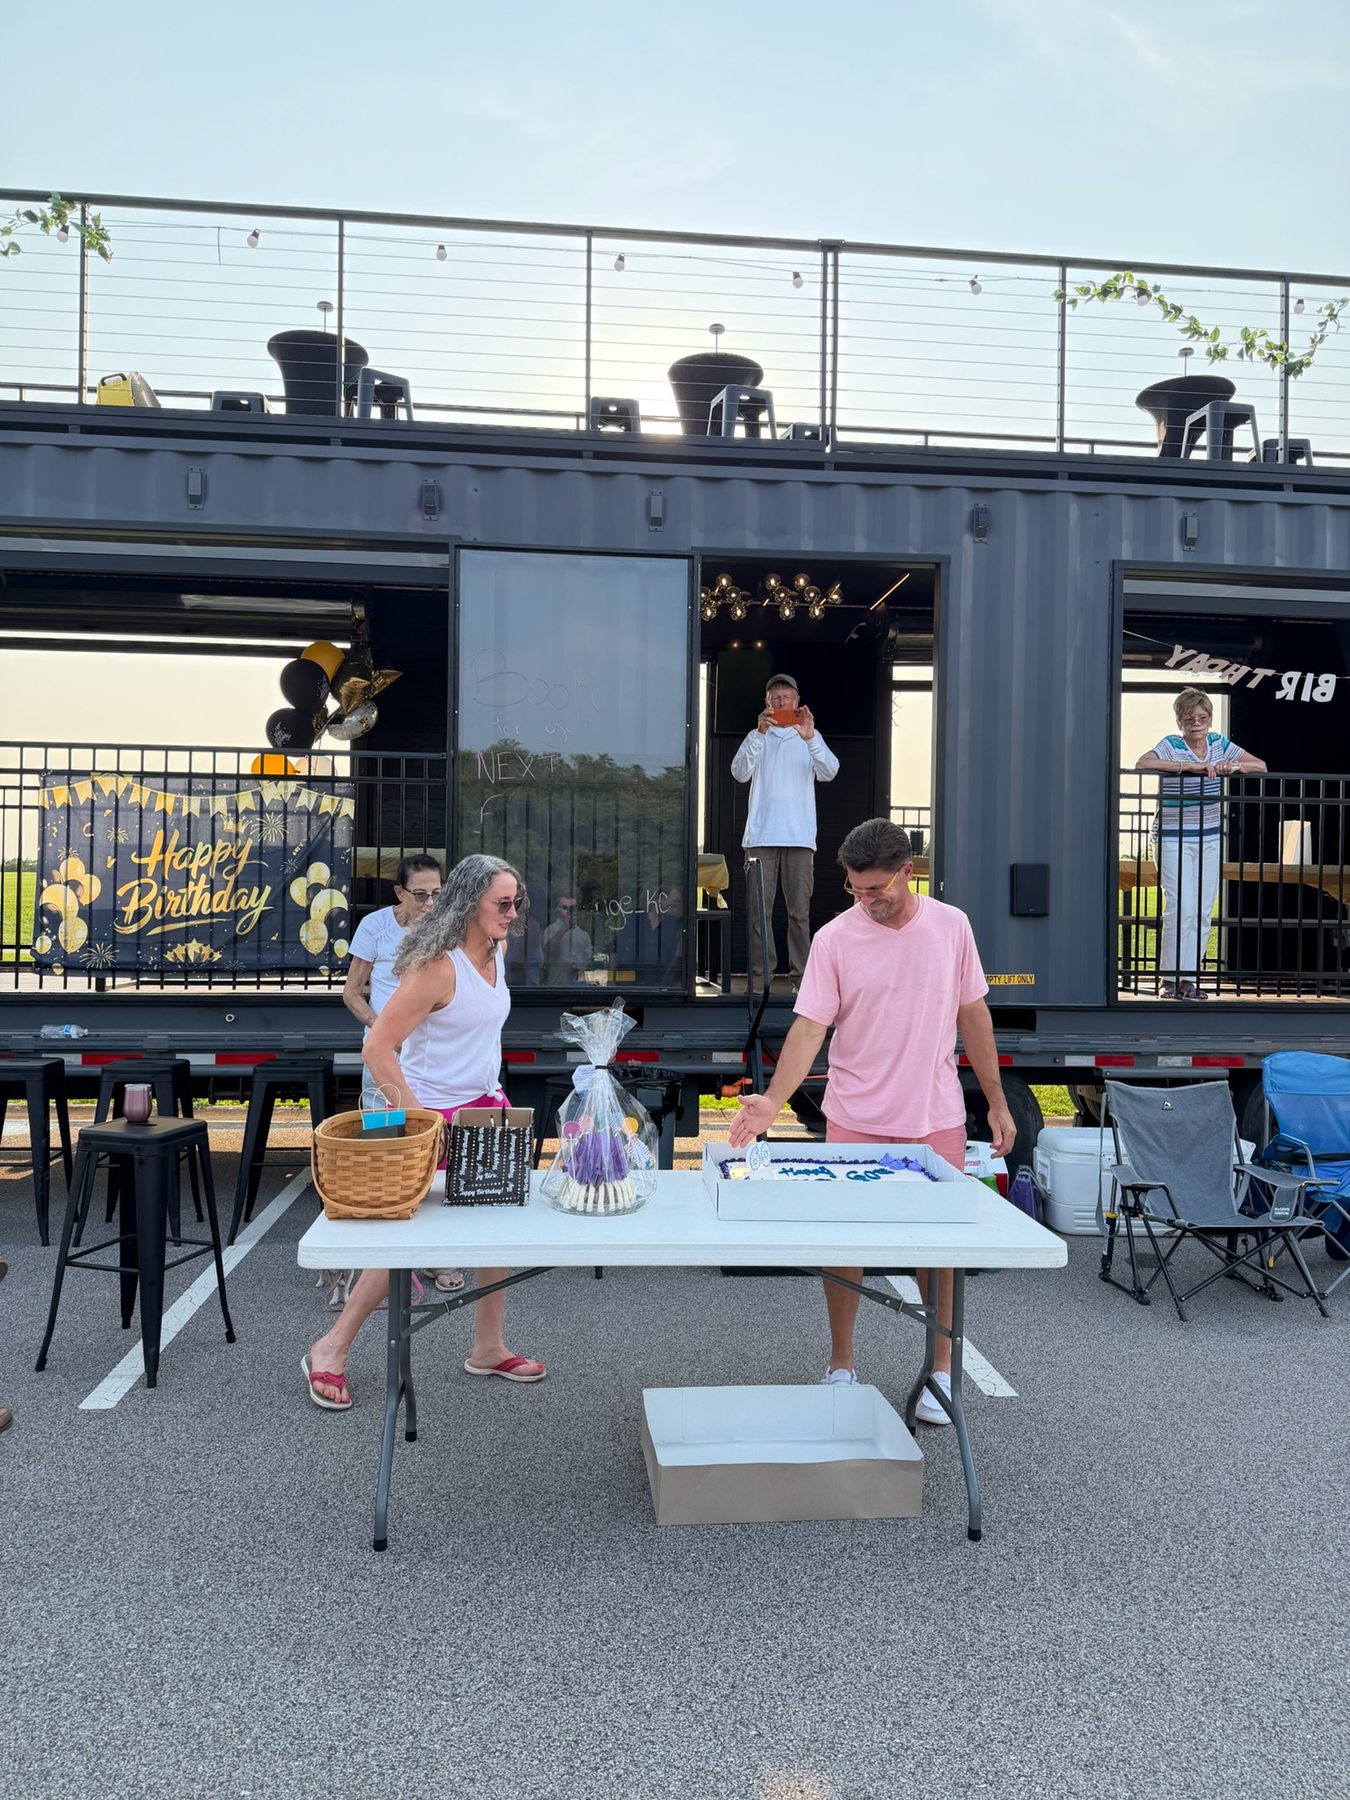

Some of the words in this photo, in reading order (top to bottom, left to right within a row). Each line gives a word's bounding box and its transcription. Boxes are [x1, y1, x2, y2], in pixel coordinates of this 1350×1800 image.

[477, 750, 556, 785] NEXT
[131, 829, 269, 892] Happy
[113, 874, 274, 936] Birthday
[984, 975, 1001, 984] MPTY
[1004, 975, 1015, 984] LIFT
[1017, 975, 1034, 984] ONLY
[460, 1130, 470, 1156] Birthday!
[477, 1143, 485, 1161] Happy
[509, 1134, 517, 1160] Birthday!
[459, 1157, 468, 1176] Happy
[492, 1153, 500, 1170] Happy
[508, 1161, 516, 1178] Happy
[476, 1187, 504, 1196] Birthday!
